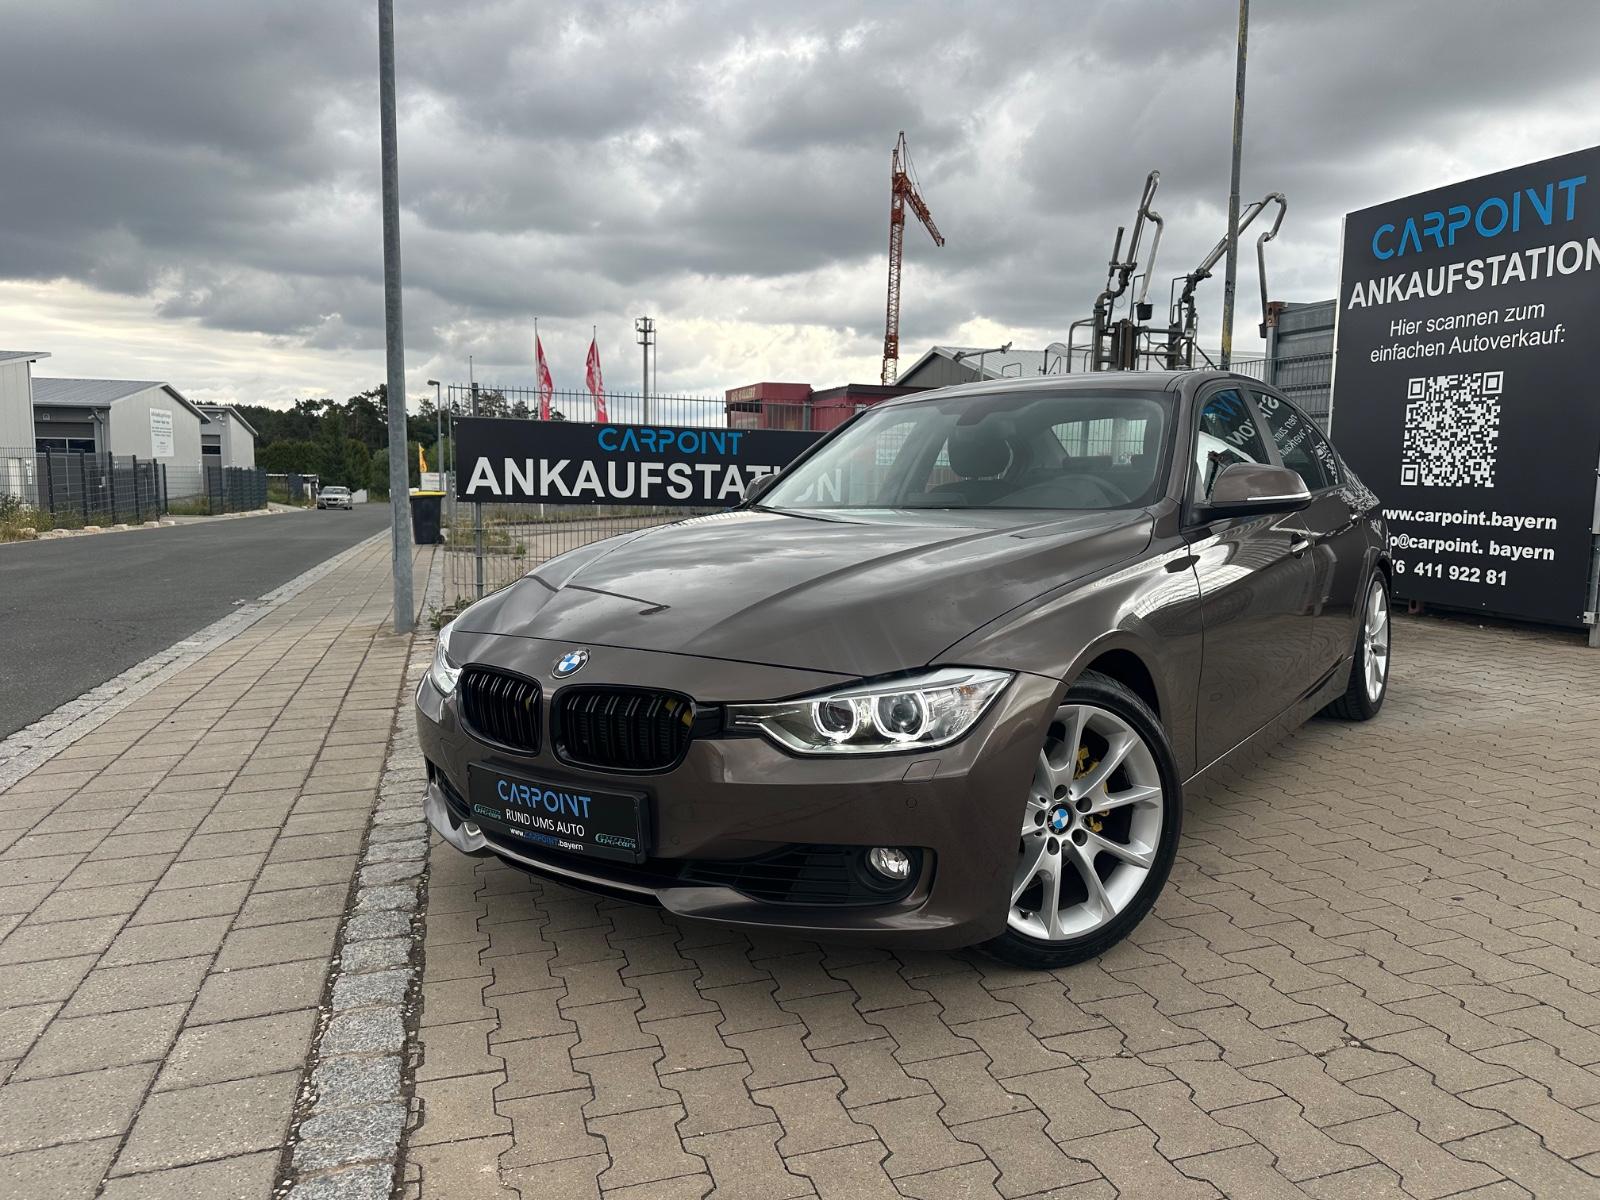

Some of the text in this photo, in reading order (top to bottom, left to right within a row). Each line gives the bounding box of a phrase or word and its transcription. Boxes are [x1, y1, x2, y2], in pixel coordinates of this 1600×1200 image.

[1372, 176, 1587, 260] CARPOINT
[1390, 303, 1545, 337] Hier scannen zum
[1370, 324, 1566, 363] einfachen Autoverkauf:
[597, 427, 743, 455] CARPOINT
[1382, 509, 1557, 532] ww.carpoint.bayern
[1489, 541, 1555, 561] bayern
[1414, 562, 1442, 579] 411
[1449, 566, 1480, 583] 922
[1486, 570, 1507, 586] 81
[497, 779, 592, 818] CARPOINT
[505, 808, 530, 825] RUND
[532, 816, 555, 831] UMS
[557, 822, 585, 837] AUTO
